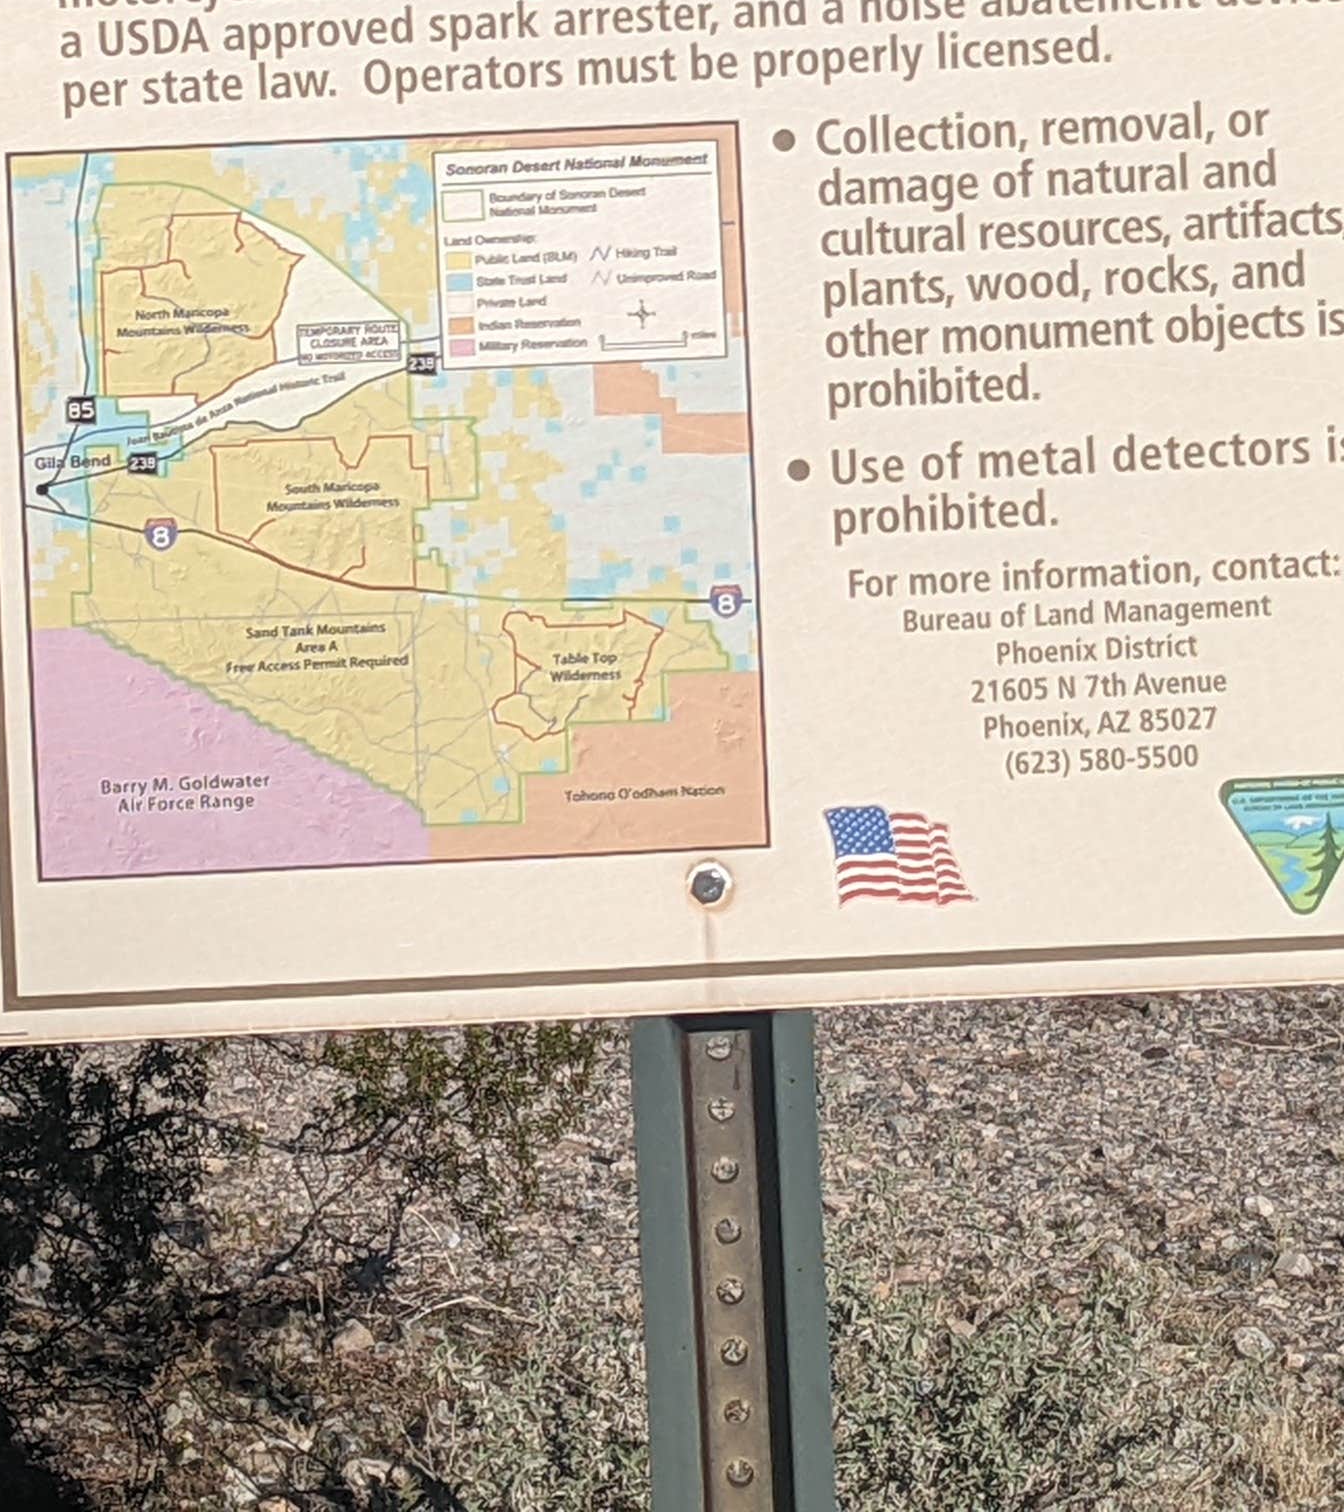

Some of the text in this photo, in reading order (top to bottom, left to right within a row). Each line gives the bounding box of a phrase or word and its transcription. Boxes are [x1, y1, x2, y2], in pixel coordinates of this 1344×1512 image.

[60, 30, 82, 59] a
[98, 16, 210, 57] USDA
[223, 4, 414, 61] approved
[428, 0, 540, 53] spark
[62, 24, 1112, 120] per state law. Operators must be properly licensed.
[816, 100, 1270, 156] Collection, removal, or
[818, 147, 1277, 213] damage of natural and
[821, 211, 966, 257] cultural
[979, 215, 1171, 251] resources,
[823, 247, 1306, 319] plants, wood, rocks, and
[825, 317, 931, 359] other
[942, 310, 1155, 355] monument
[1165, 302, 1306, 353] objects
[828, 361, 1041, 421] prohibited.
[68, 401, 95, 419] 85
[34, 454, 112, 470] Gila Bend
[831, 448, 905, 486] Use
[921, 440, 964, 481] of
[978, 434, 1096, 479] metal
[1112, 433, 1310, 473] detectors
[833, 487, 1059, 547] prohibited.
[152, 526, 170, 547] 8
[848, 549, 1341, 599] For more information, contact:
[717, 593, 735, 613] 8
[903, 595, 1272, 633] Bureau of Land Management
[246, 622, 386, 639] Sand Tank Mountains
[295, 640, 338, 653] Area A
[552, 652, 618, 666] Table Top
[996, 632, 1198, 666] Phoenix District
[550, 669, 621, 682] Wilderness
[971, 671, 1227, 704] 21605 N 7th Avenue
[983, 705, 1218, 740] Phoenix, AZ 85027
[1005, 743, 1199, 780] (623) 580-5500
[100, 773, 270, 797] Barry M. Goldwater
[118, 794, 255, 813] Air Force Range
